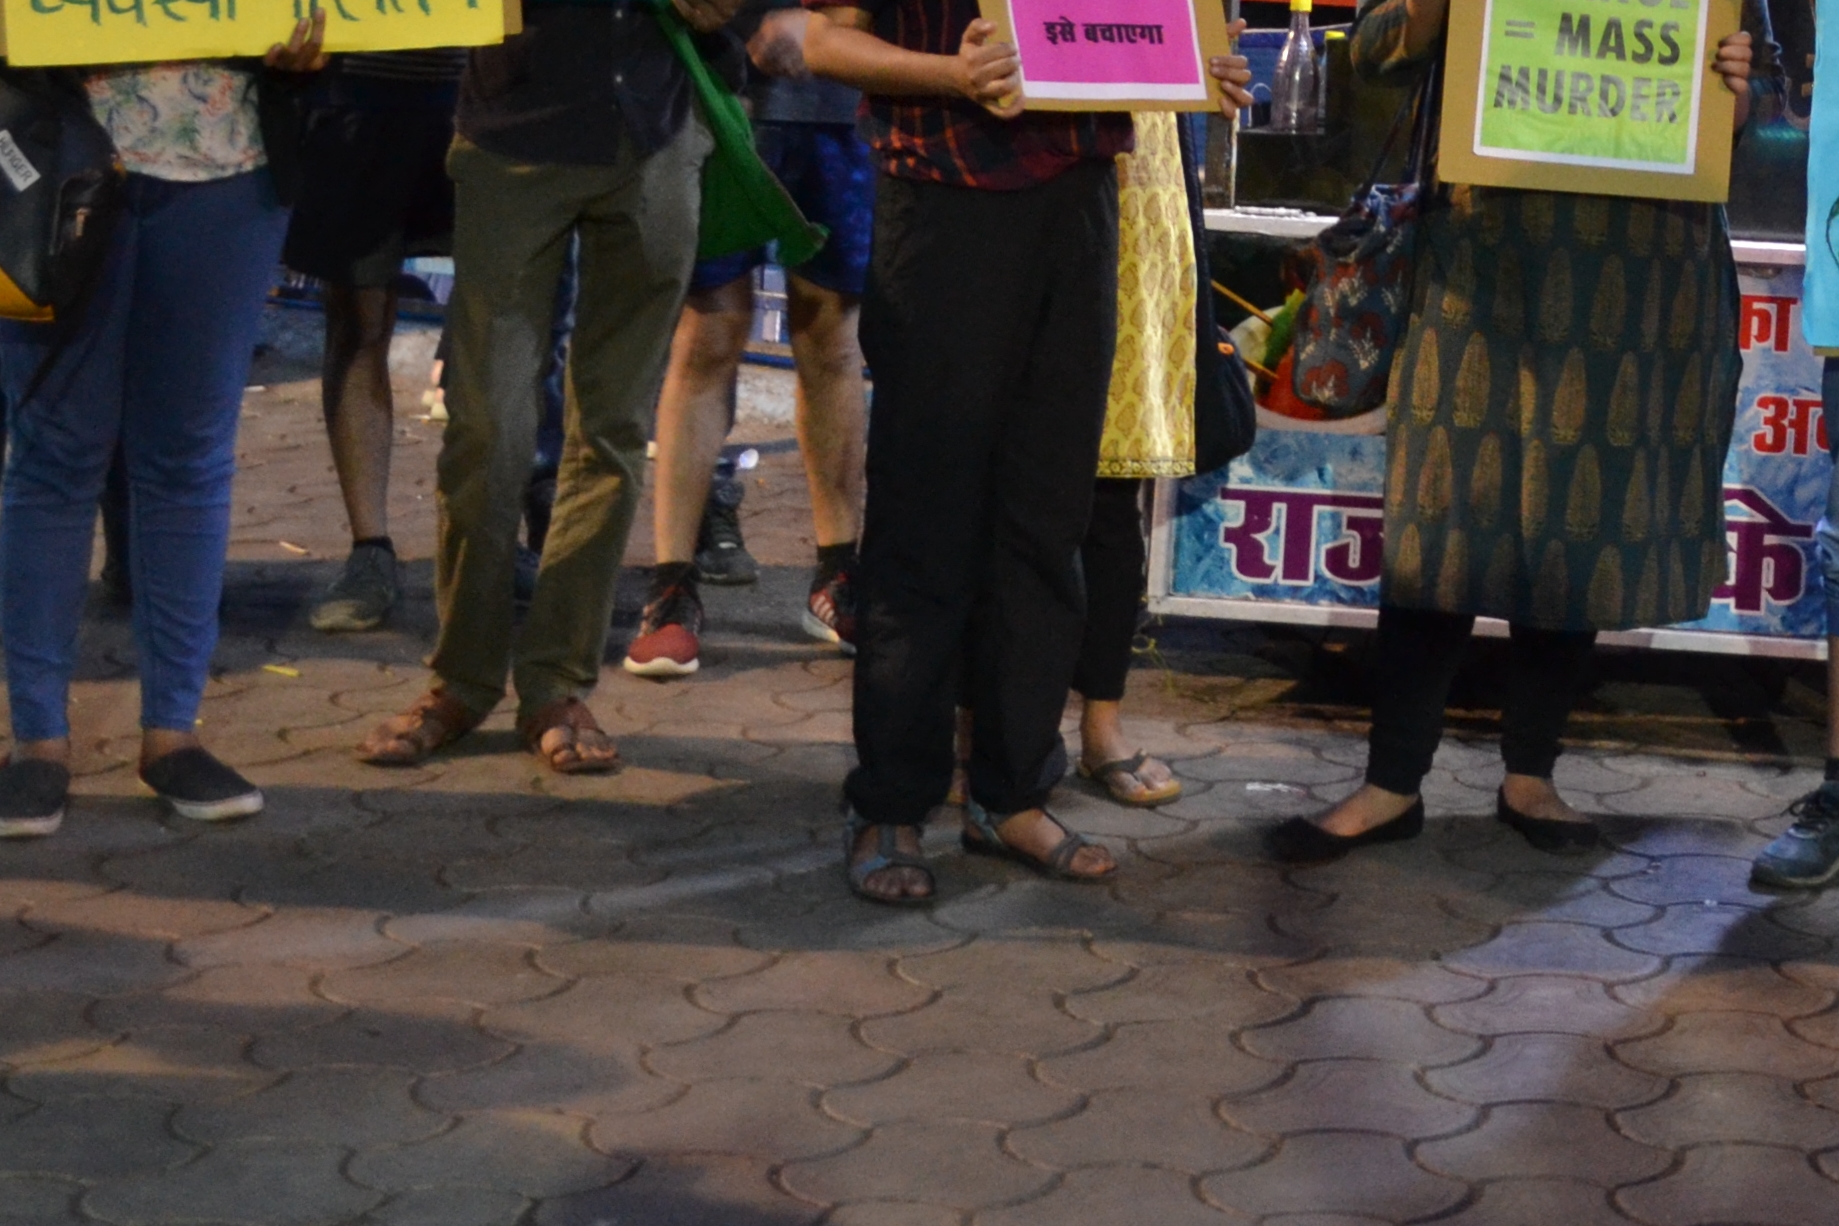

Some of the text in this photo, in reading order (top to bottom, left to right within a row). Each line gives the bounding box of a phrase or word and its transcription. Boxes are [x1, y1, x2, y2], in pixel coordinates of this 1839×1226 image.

[1043, 16, 1163, 44] इसे बचाएगा
[1554, 12, 1680, 66] MASS
[1493, 64, 1680, 124] MURDER
